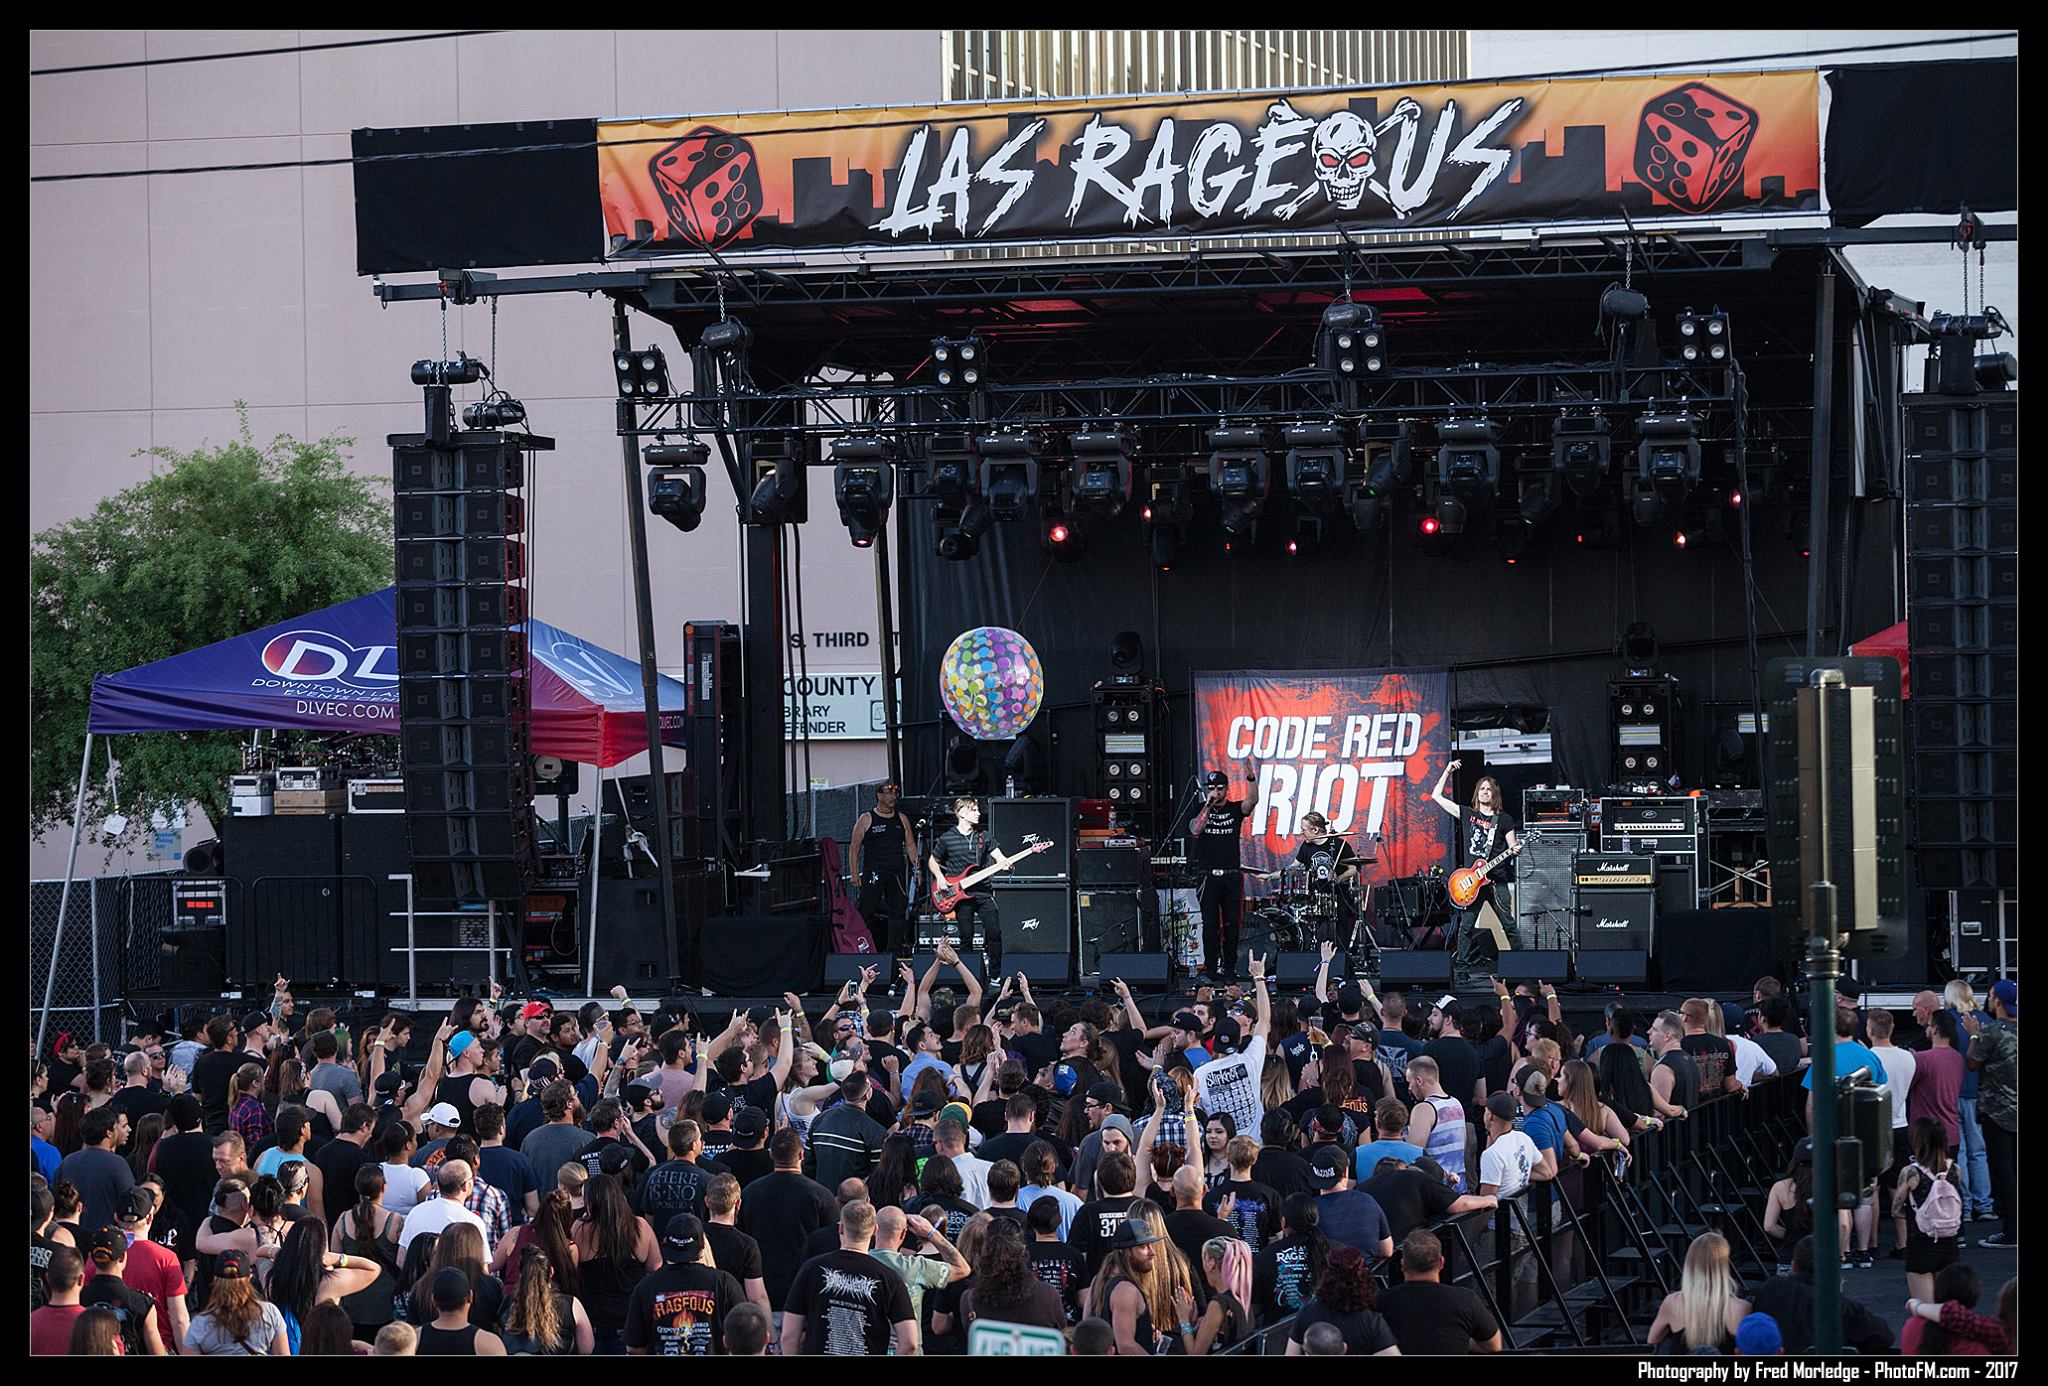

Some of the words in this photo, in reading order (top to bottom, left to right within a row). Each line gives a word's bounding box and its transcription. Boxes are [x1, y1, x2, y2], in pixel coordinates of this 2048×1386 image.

[868, 118, 1046, 242] LAS
[812, 631, 869, 648] THIRD
[252, 678, 366, 696] DOWNTOWN
[783, 676, 876, 697] COUNTY
[296, 700, 395, 720] DLVEC.COM
[1227, 716, 1332, 760] CODE
[1341, 713, 1422, 758] RED
[1251, 762, 1404, 841] RIOT
[1597, 862, 1630, 872] Marshall
[1596, 918, 1629, 928] Marshall
